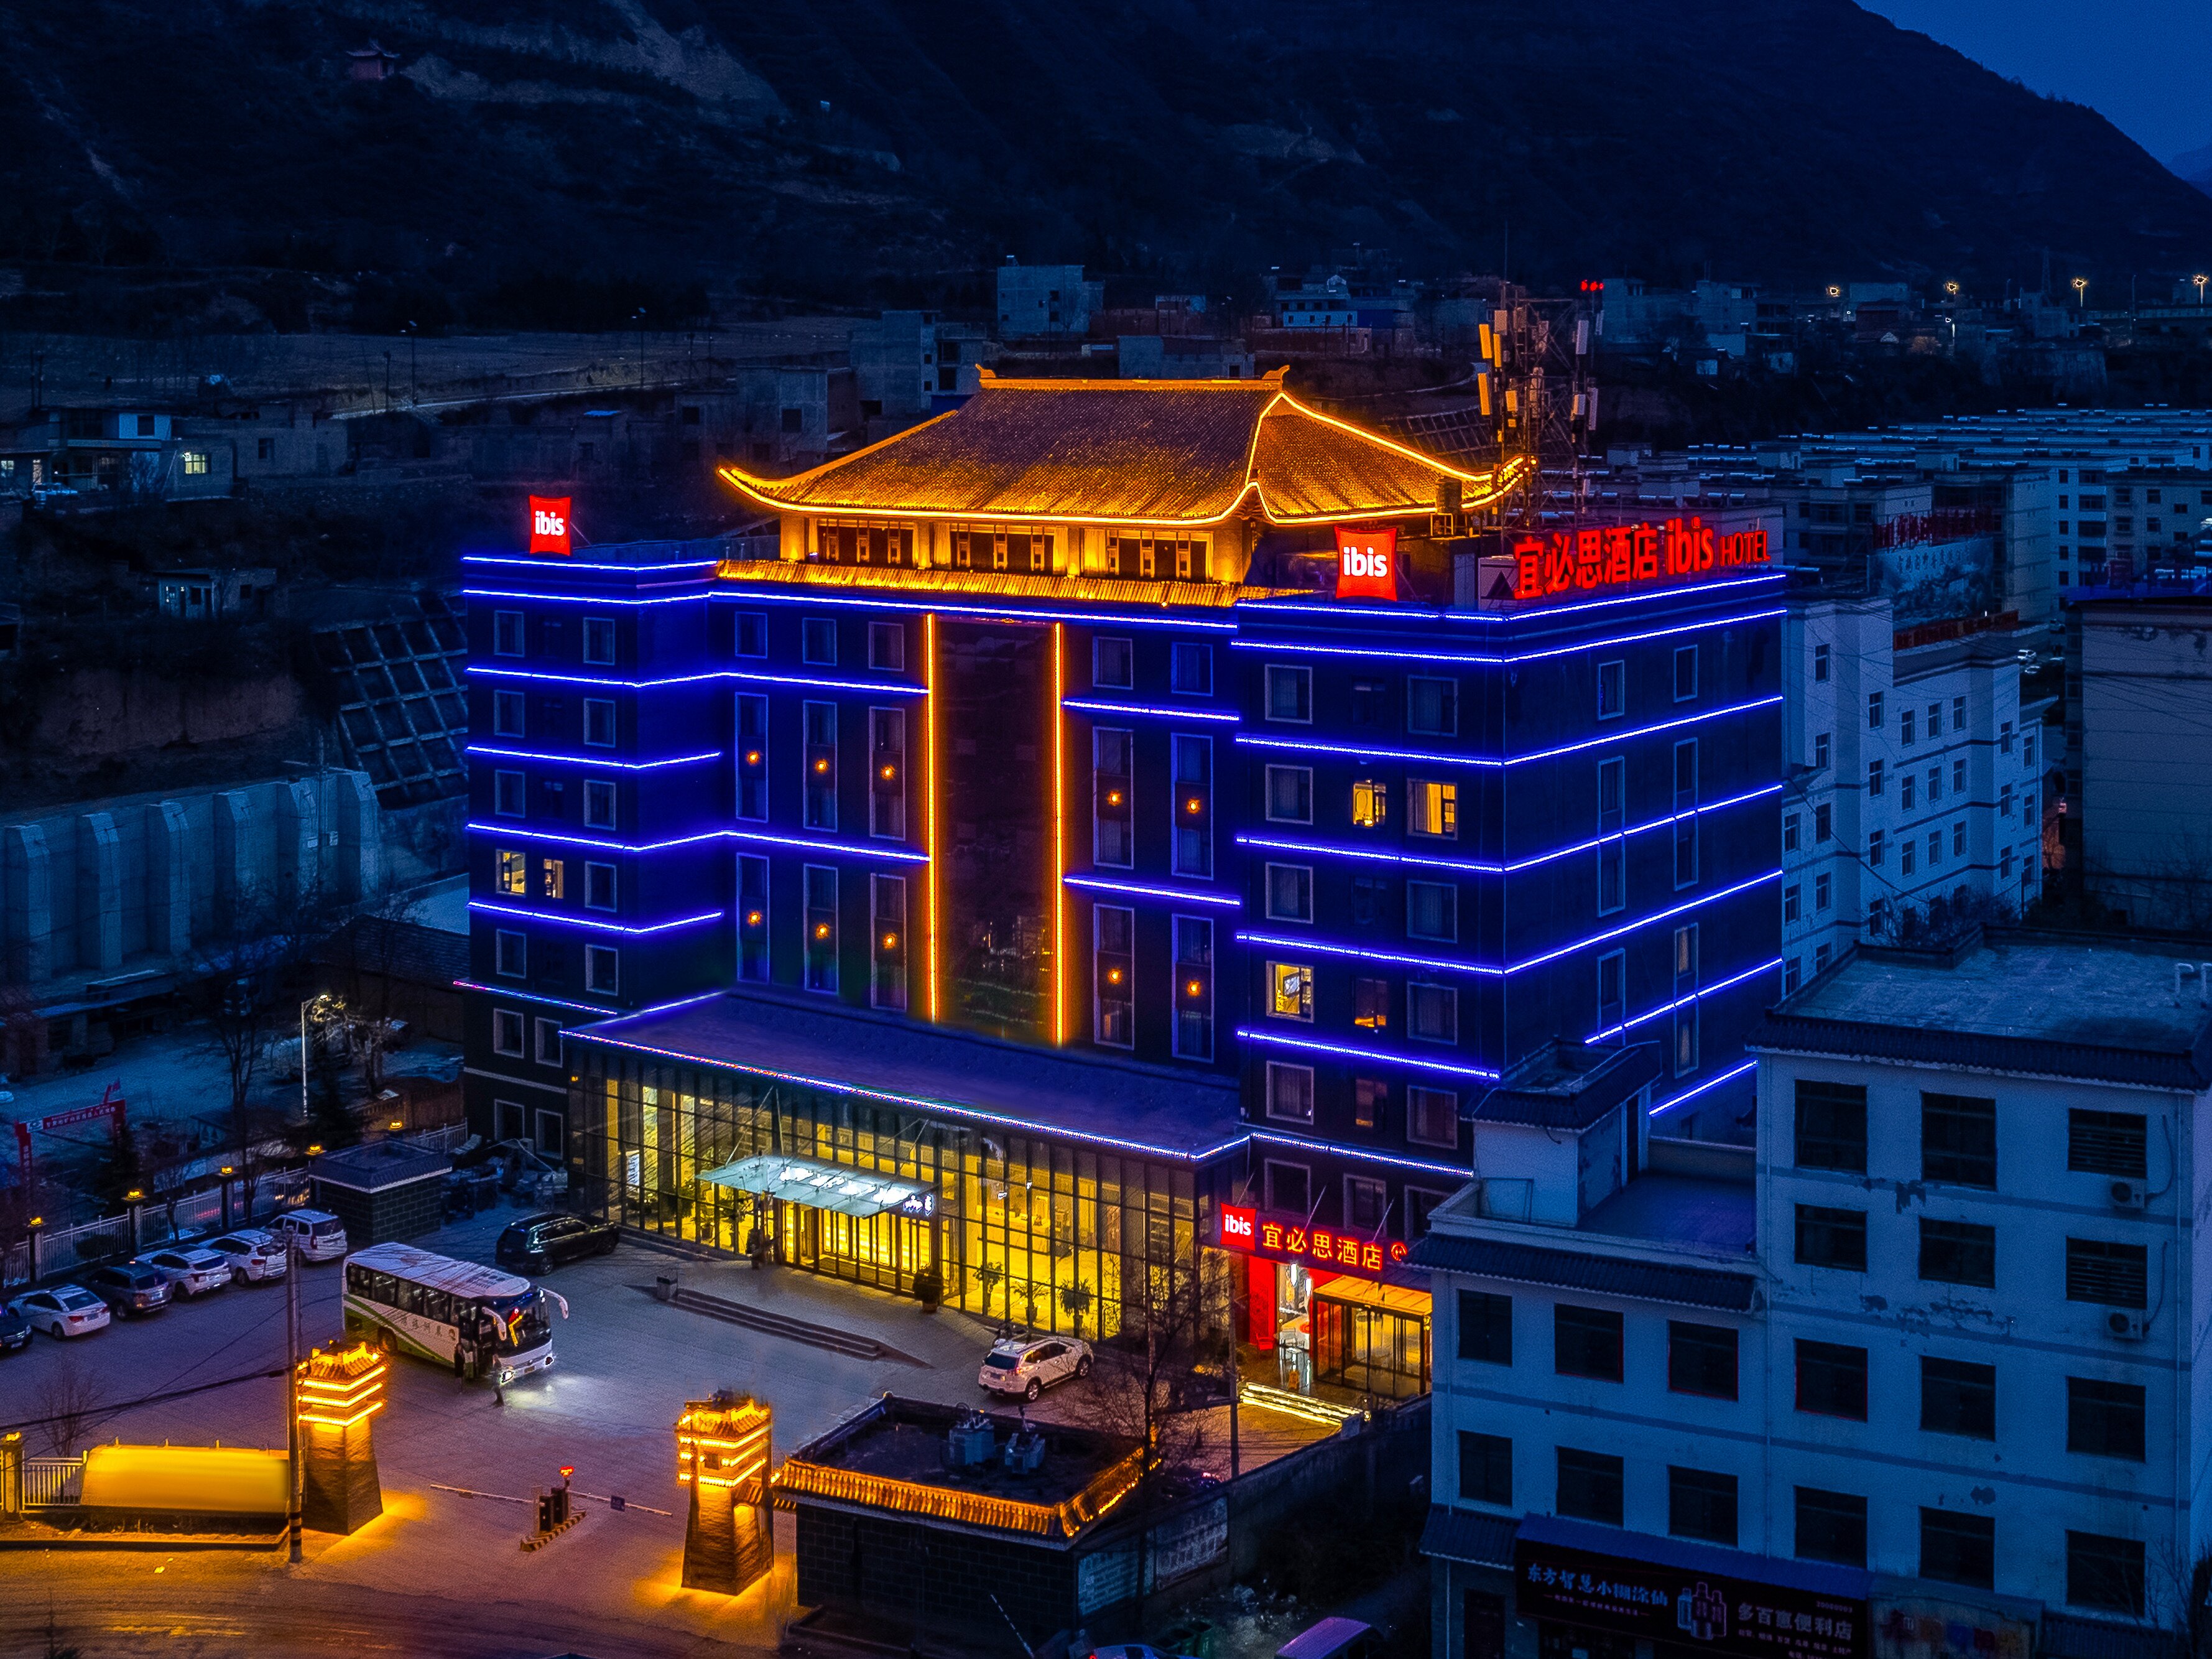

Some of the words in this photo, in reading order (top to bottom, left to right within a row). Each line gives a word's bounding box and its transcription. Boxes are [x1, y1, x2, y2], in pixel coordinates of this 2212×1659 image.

[535, 510, 565, 536] ibis
[1343, 546, 1387, 577] ibis
[1514, 522, 1658, 600] 宜必思酒店
[1665, 516, 1714, 575] ibis
[1719, 530, 1771, 567] HOTEL
[1224, 1214, 1252, 1235] ibis
[1262, 1223, 1383, 1271] 宜必思酒店
